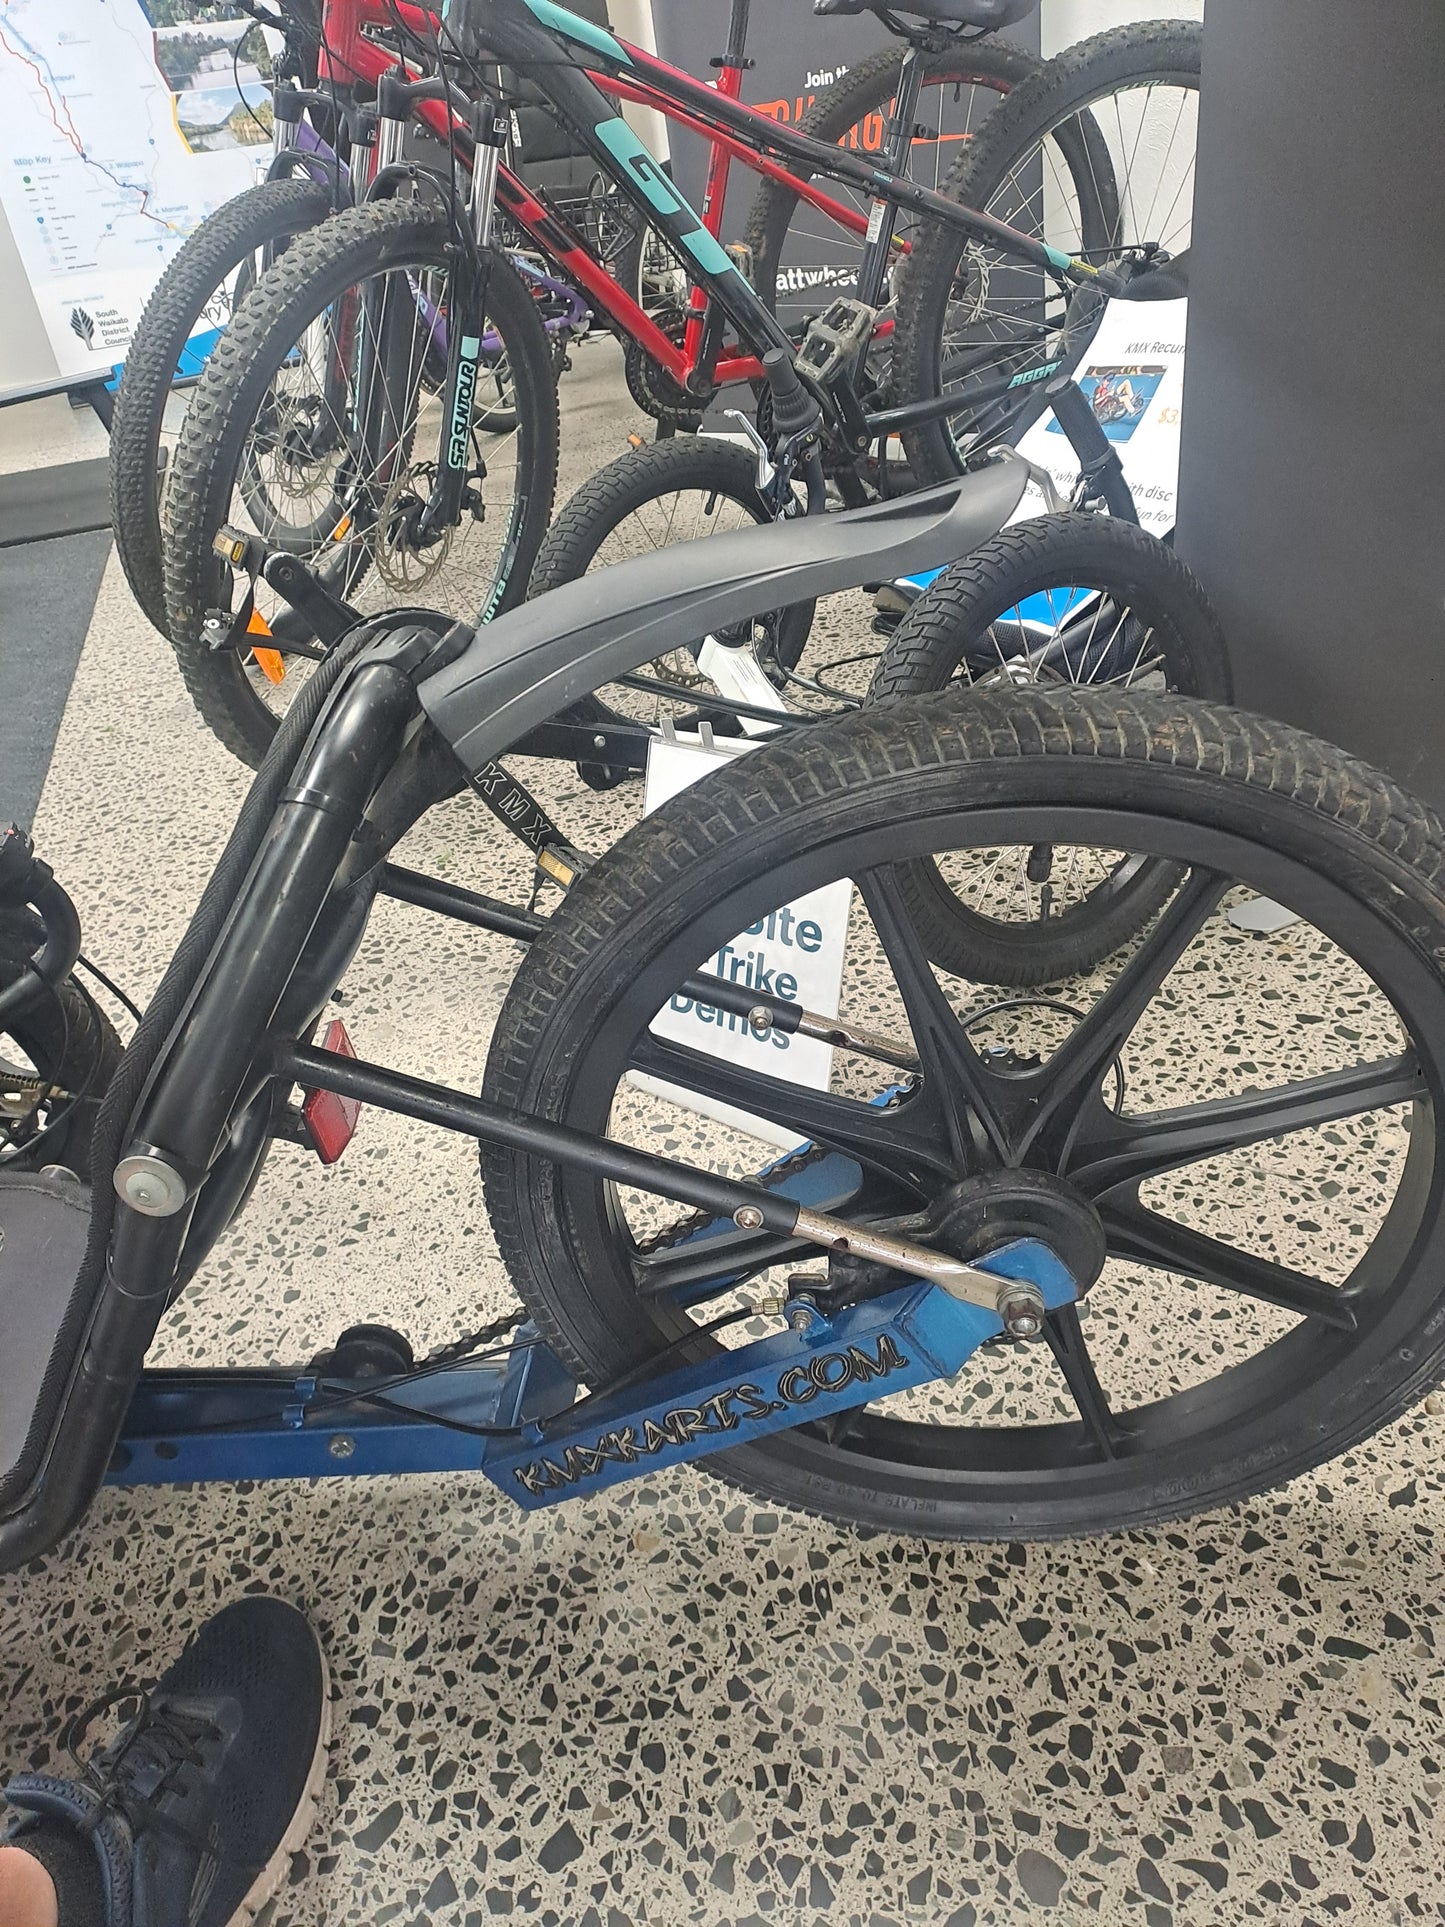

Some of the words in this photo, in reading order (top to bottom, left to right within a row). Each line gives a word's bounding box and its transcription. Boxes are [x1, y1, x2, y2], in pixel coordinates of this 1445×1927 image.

[804, 69, 834, 88] Join
[95, 309, 118, 318] South
[98, 318, 129, 327] Waikato
[101, 326, 130, 336] District
[1124, 342, 1151, 354] KMX
[1007, 361, 1063, 390] AGGR
[453, 361, 477, 438] SUNTOUR
[1145, 485, 1173, 501] disc
[1153, 510, 1174, 523] for
[474, 761, 552, 845] KMX
[717, 944, 798, 1000] Trike
[512, 1333, 909, 1496] KMXKARTS.COM
